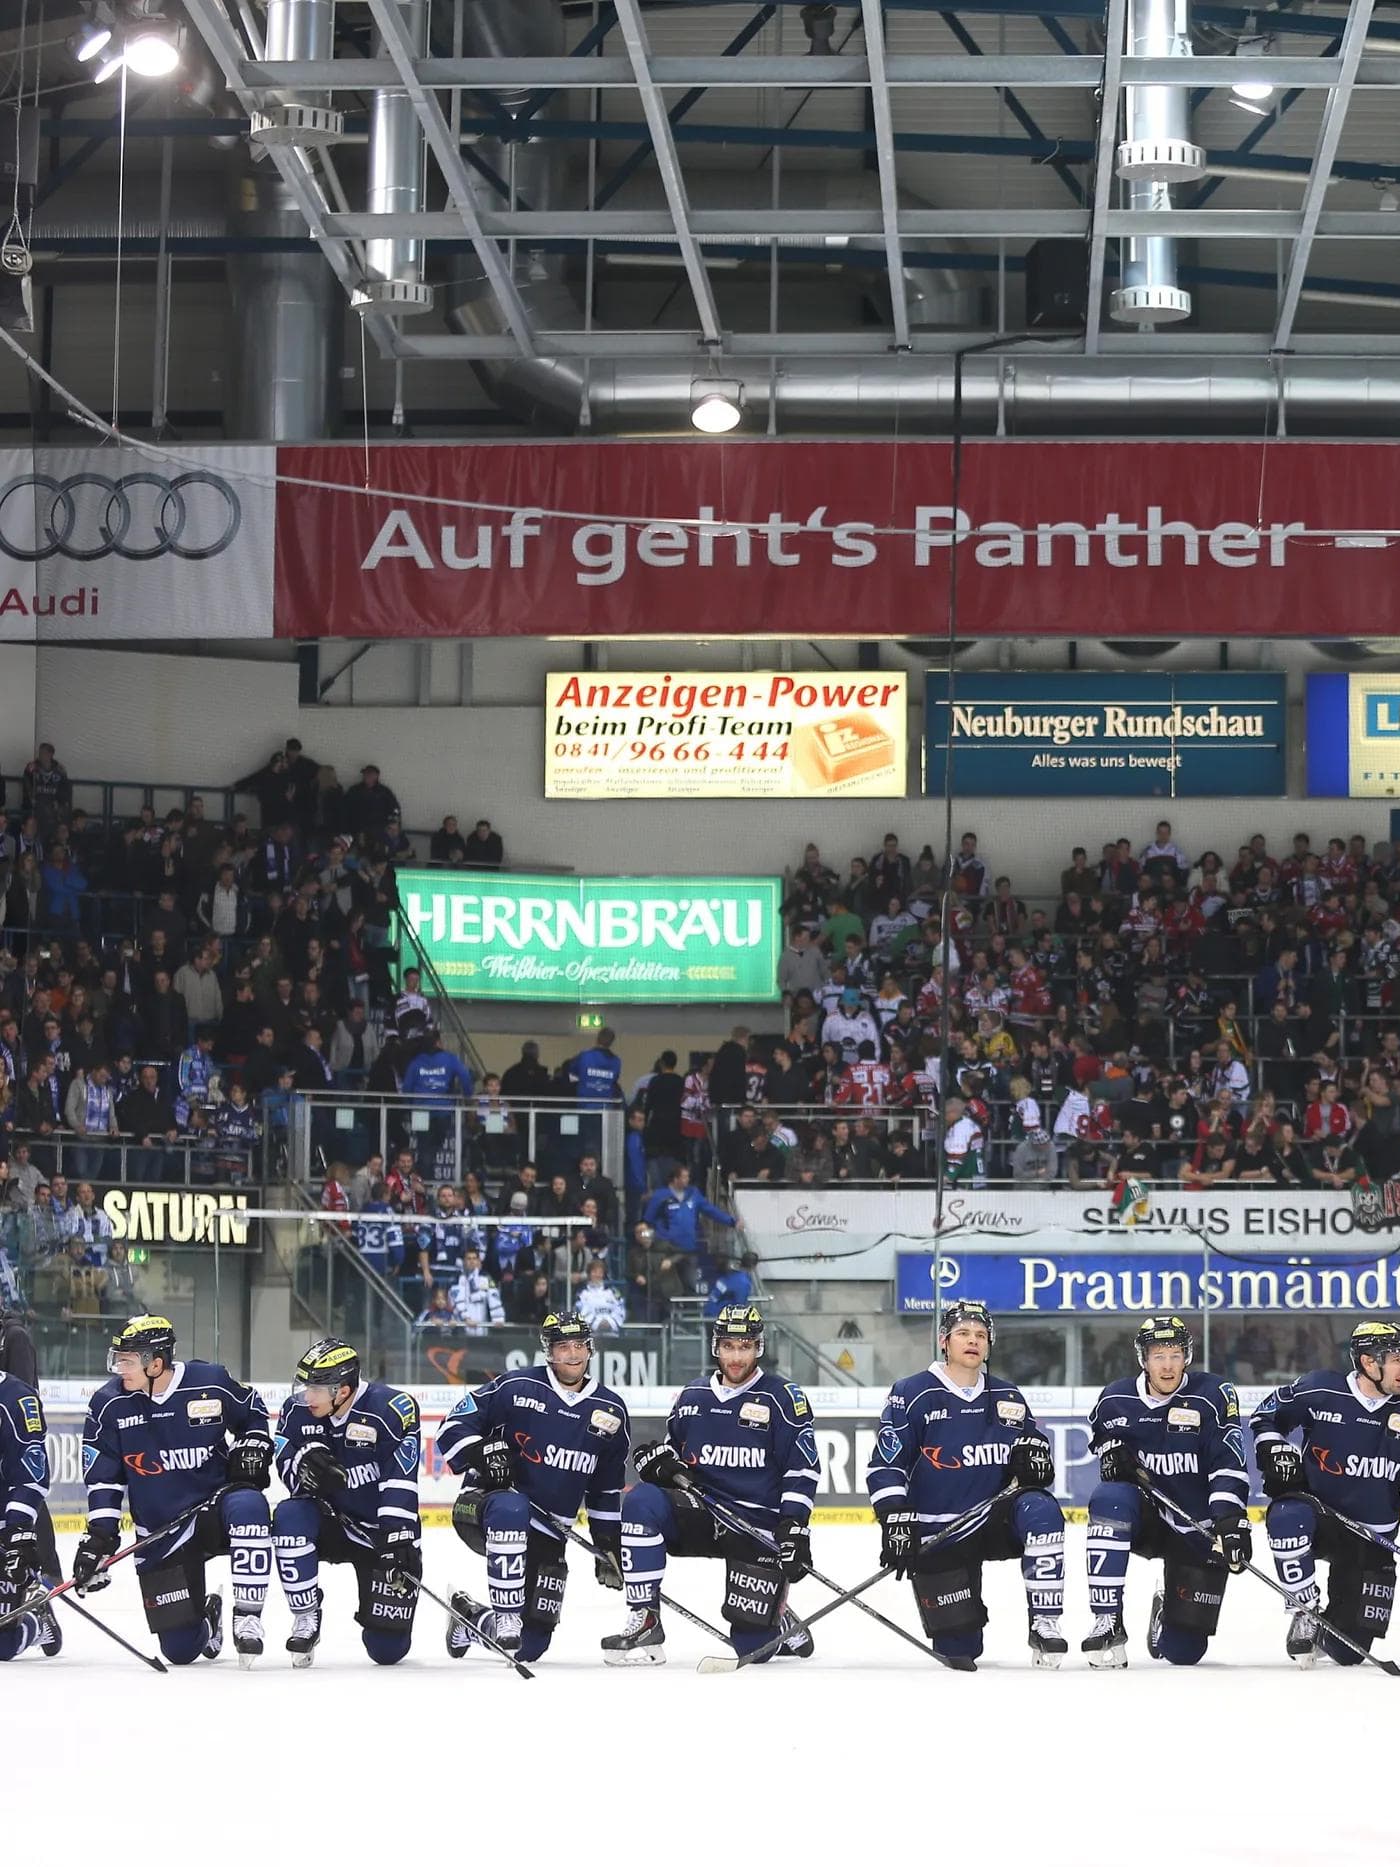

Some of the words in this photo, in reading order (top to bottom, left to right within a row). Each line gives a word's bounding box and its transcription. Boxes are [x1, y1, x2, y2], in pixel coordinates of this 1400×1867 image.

[360, 506, 545, 570] Auf
[914, 505, 1305, 568] Panther
[0, 586, 99, 617] Audi
[554, 715, 627, 736] beim
[951, 706, 1099, 745] Neuburger
[1103, 706, 1265, 738] Rundschau
[1031, 753, 1066, 769] Alles
[1068, 756, 1097, 769] was
[1100, 756, 1126, 769] uns
[1128, 753, 1182, 772] bewegt
[406, 892, 764, 952] HERRNBRÄU
[102, 1188, 249, 1245] SATURN
[700, 1443, 766, 1469] SATURN
[232, 1548, 269, 1575] 20
[494, 1555, 525, 1579] 14
[1282, 1559, 1303, 1583] 6
[728, 1568, 780, 1595] HERRN
[155, 1587, 191, 1606] SATURN
[726, 1592, 769, 1616] BRÄU
[936, 1587, 972, 1606] SATURN
[372, 1601, 413, 1620] BRÄU
